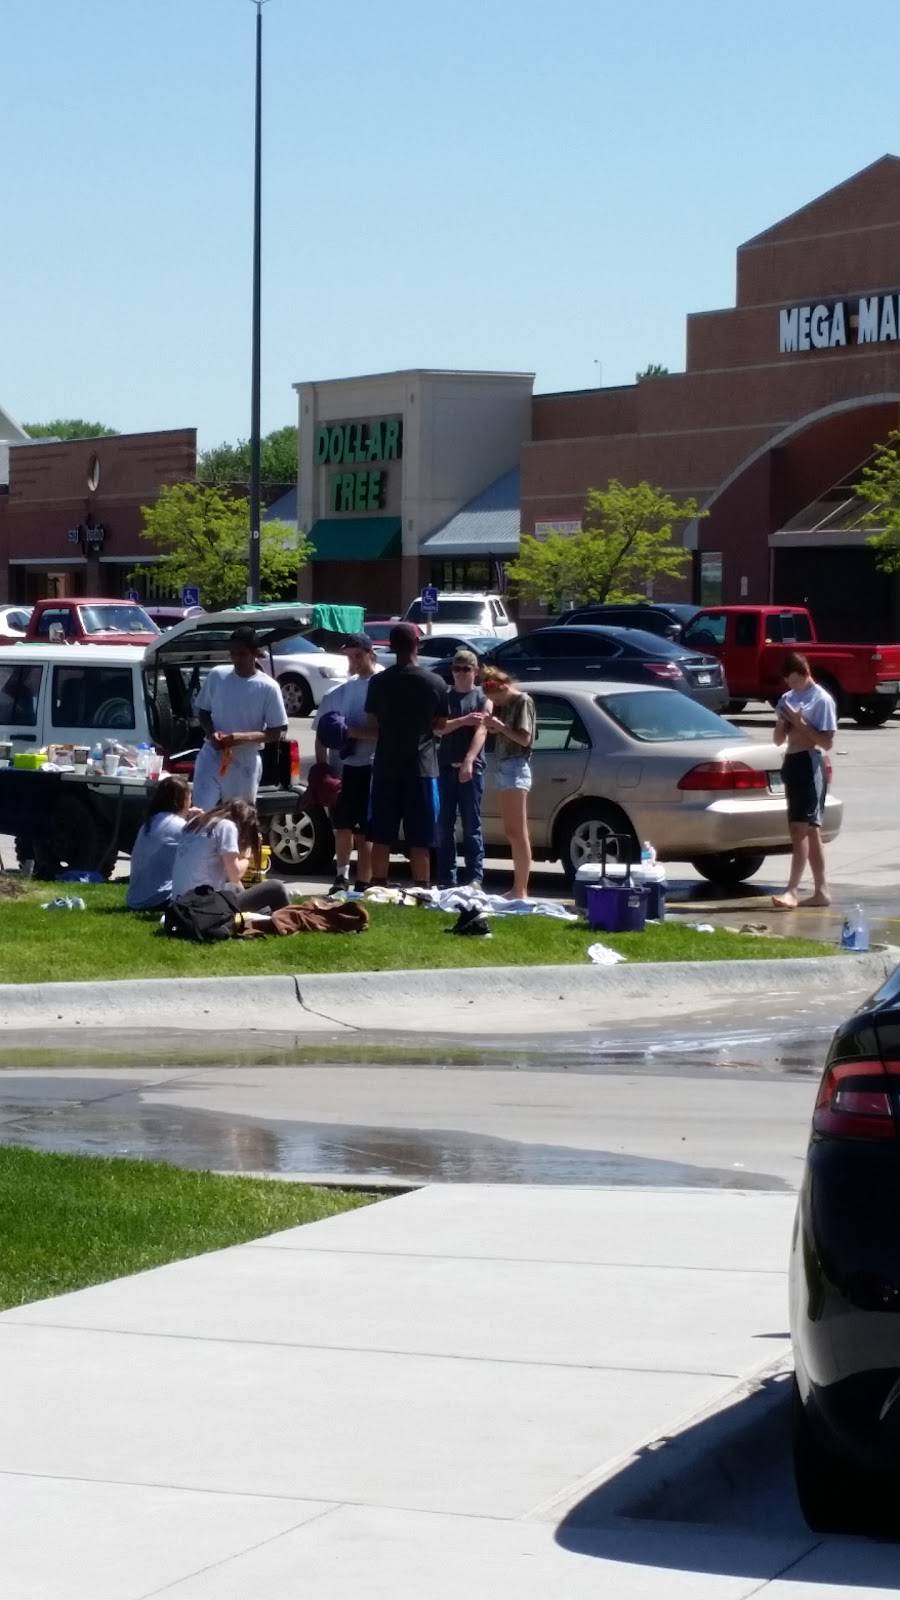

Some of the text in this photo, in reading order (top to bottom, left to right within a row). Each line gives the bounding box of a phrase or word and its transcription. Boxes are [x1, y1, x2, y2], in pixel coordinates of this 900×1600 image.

[779, 294, 900, 353] MEGA MA
[313, 417, 400, 464] DOLLAR
[329, 470, 383, 512] TREE
